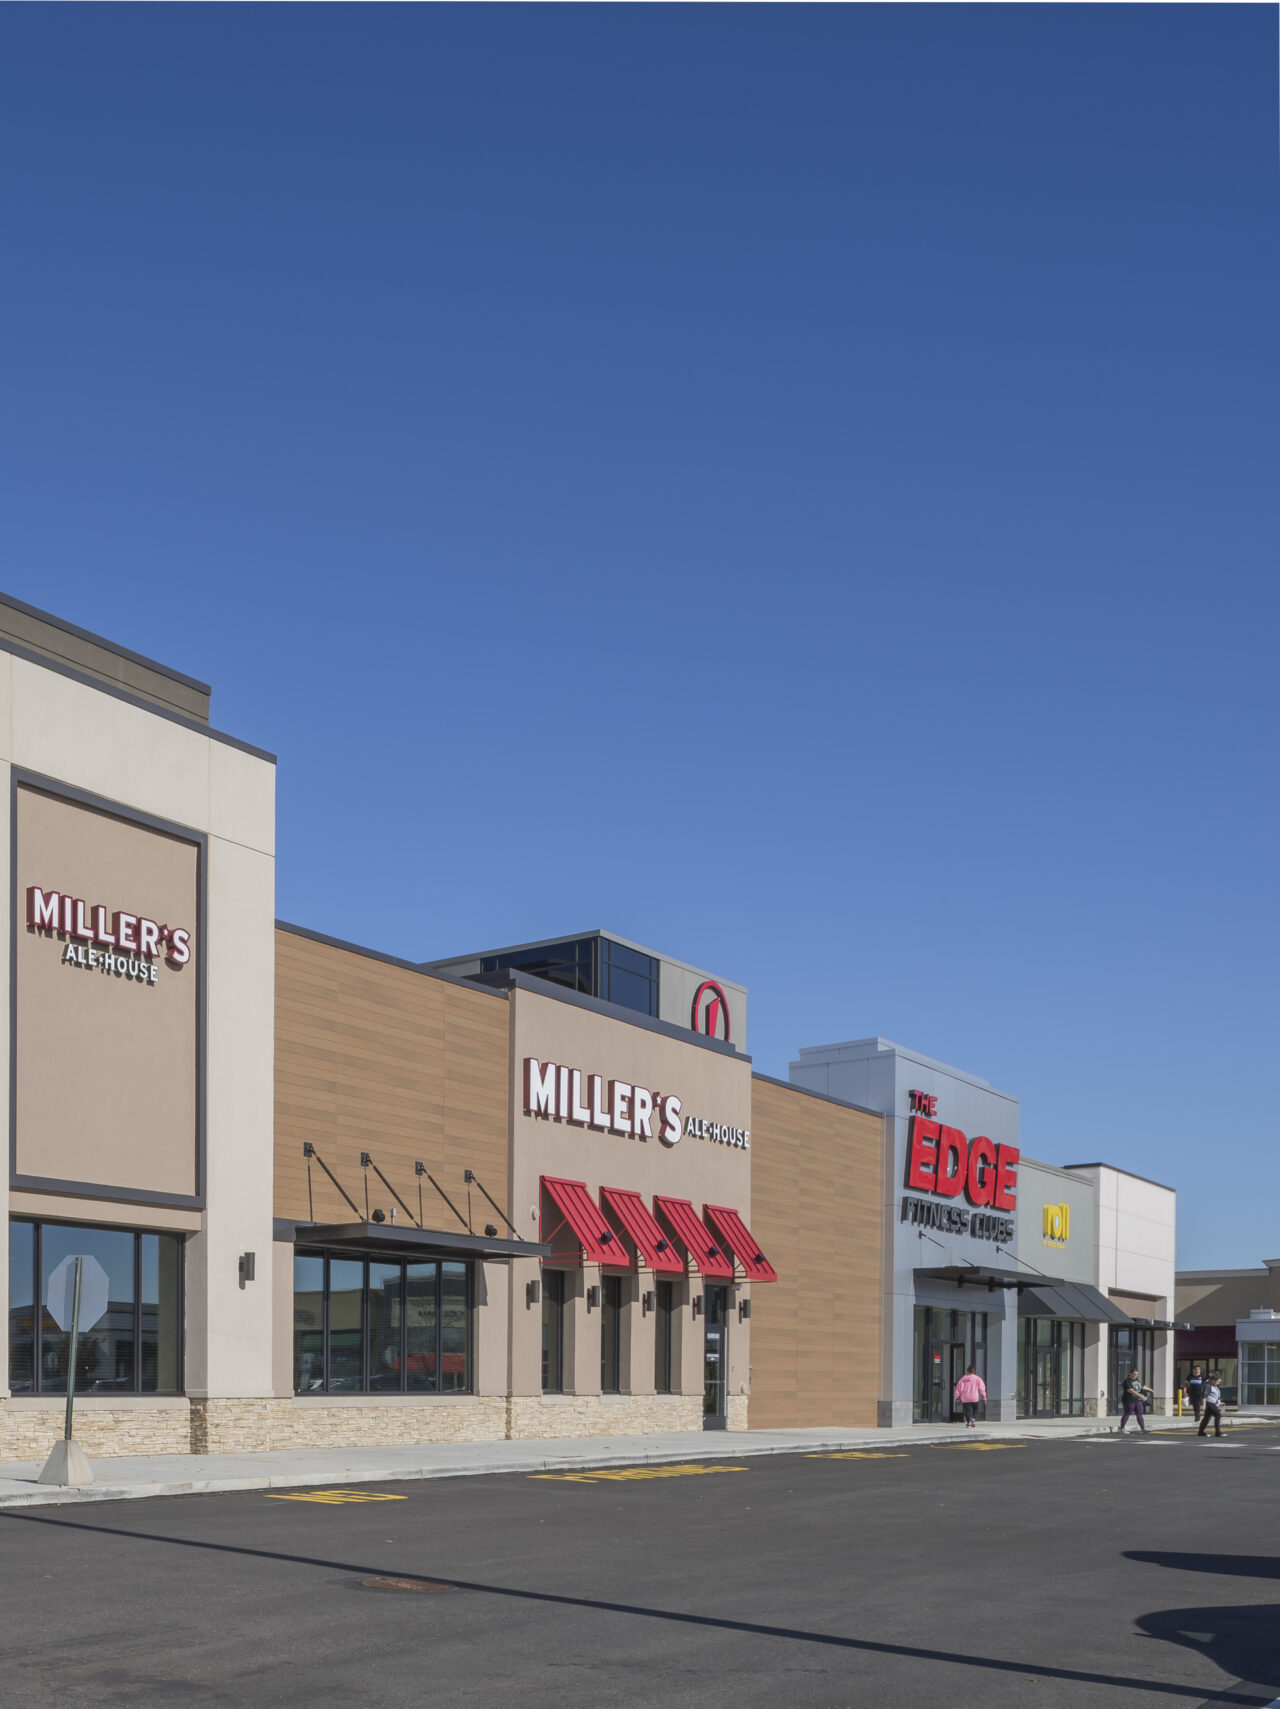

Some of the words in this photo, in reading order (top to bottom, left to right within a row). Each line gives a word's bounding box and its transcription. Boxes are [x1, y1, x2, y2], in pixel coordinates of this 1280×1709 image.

[26, 886, 190, 964] MILLER'S
[524, 1057, 682, 1144] MILLER'S
[909, 1089, 938, 1116] THE
[905, 1115, 1020, 1211] EDGE
[903, 1197, 970, 1235] FITNESS
[971, 1213, 1015, 1243] CLUBS
